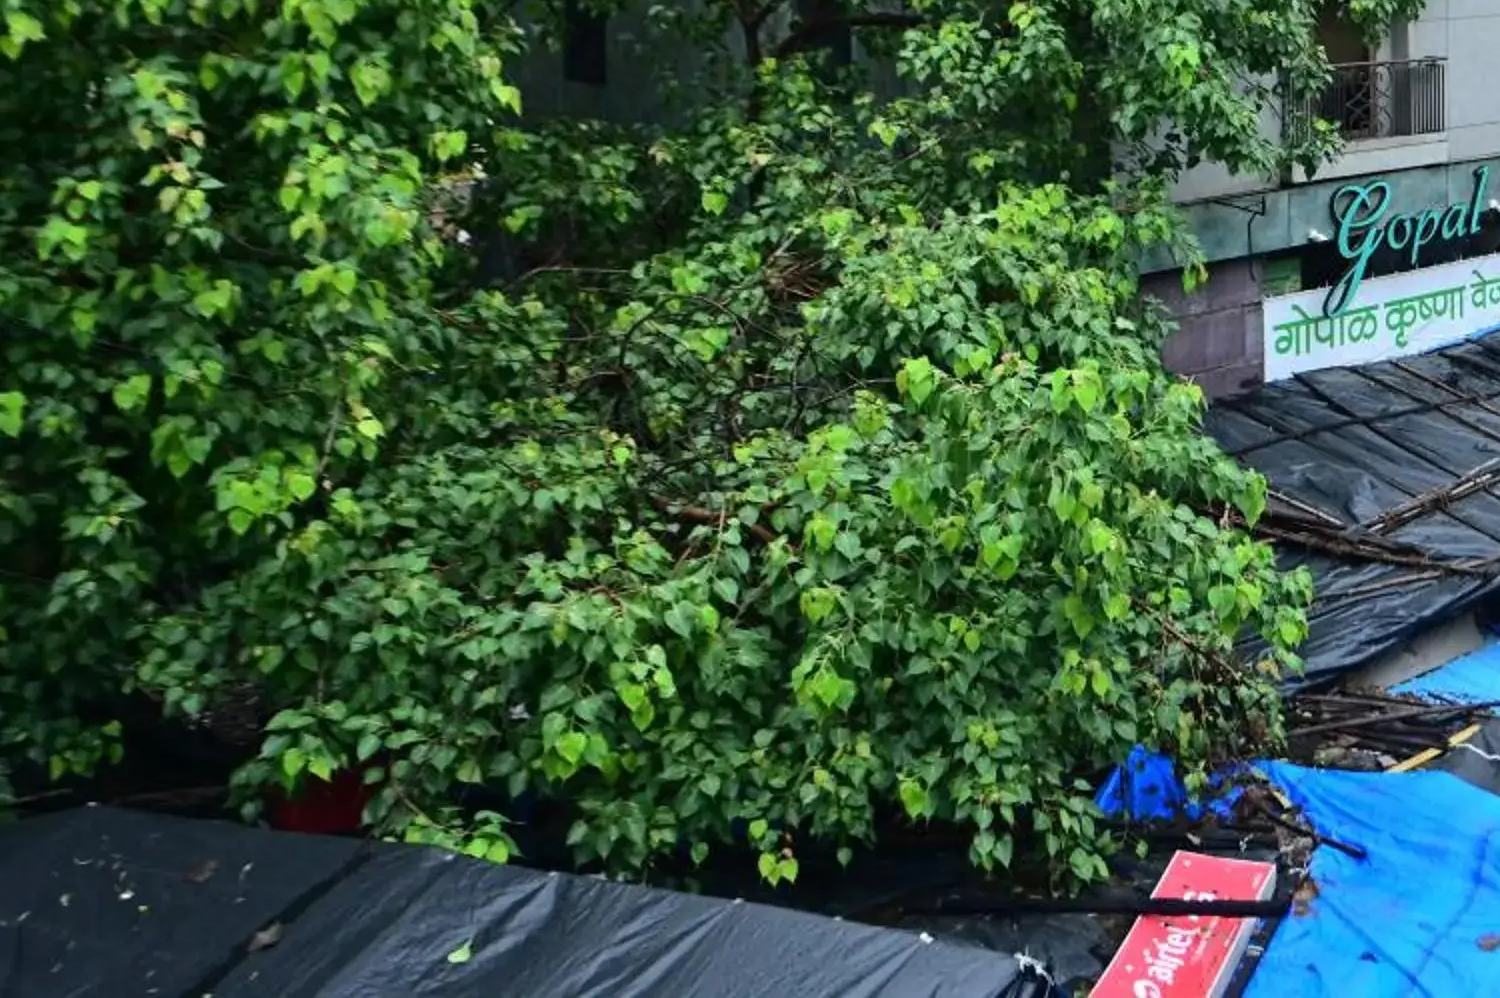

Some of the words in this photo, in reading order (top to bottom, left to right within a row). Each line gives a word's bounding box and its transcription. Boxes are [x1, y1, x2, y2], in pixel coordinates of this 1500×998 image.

[1323, 163, 1490, 318] Gopal
[1383, 284, 1466, 348] कृष्णा
[1143, 923, 1201, 986] airtel
